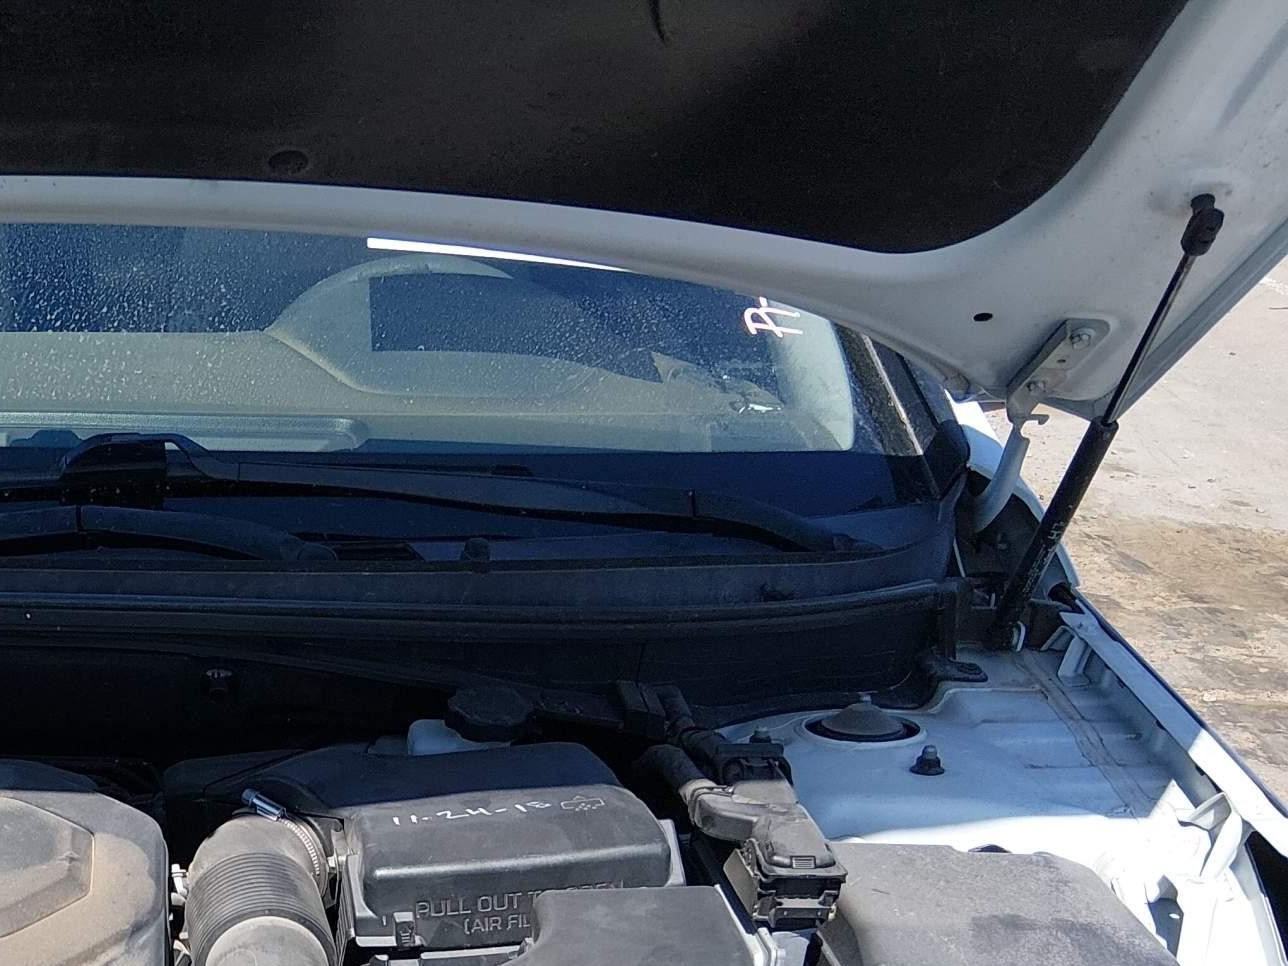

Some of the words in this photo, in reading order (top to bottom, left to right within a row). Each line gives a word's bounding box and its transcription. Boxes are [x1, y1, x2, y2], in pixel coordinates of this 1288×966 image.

[415, 898, 472, 919] PULL
[477, 892, 523, 913] OUT
[463, 915, 503, 934] (AIR
